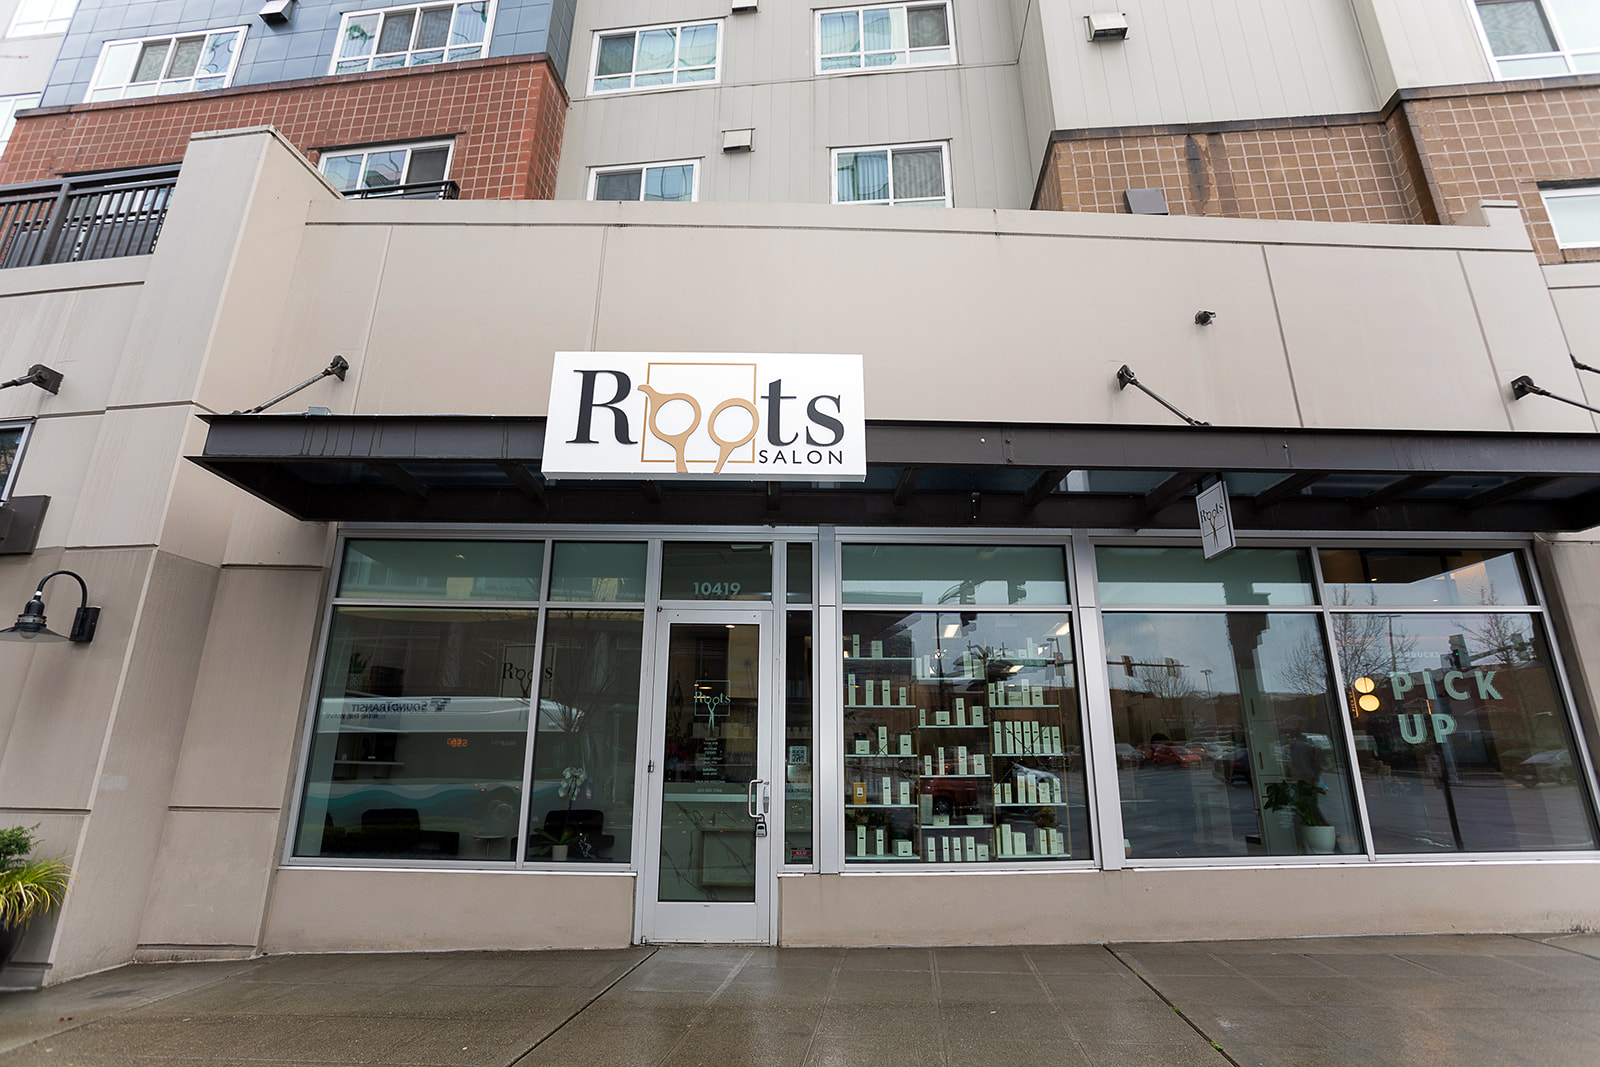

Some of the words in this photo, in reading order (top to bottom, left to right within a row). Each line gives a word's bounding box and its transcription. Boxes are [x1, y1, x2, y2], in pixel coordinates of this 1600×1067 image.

[566, 369, 845, 447] Roots
[758, 449, 843, 465] SALON
[1200, 503, 1224, 523] Roots
[693, 582, 741, 596] 10419
[1390, 670, 1503, 700] PICK
[1398, 714, 1458, 744] UP
